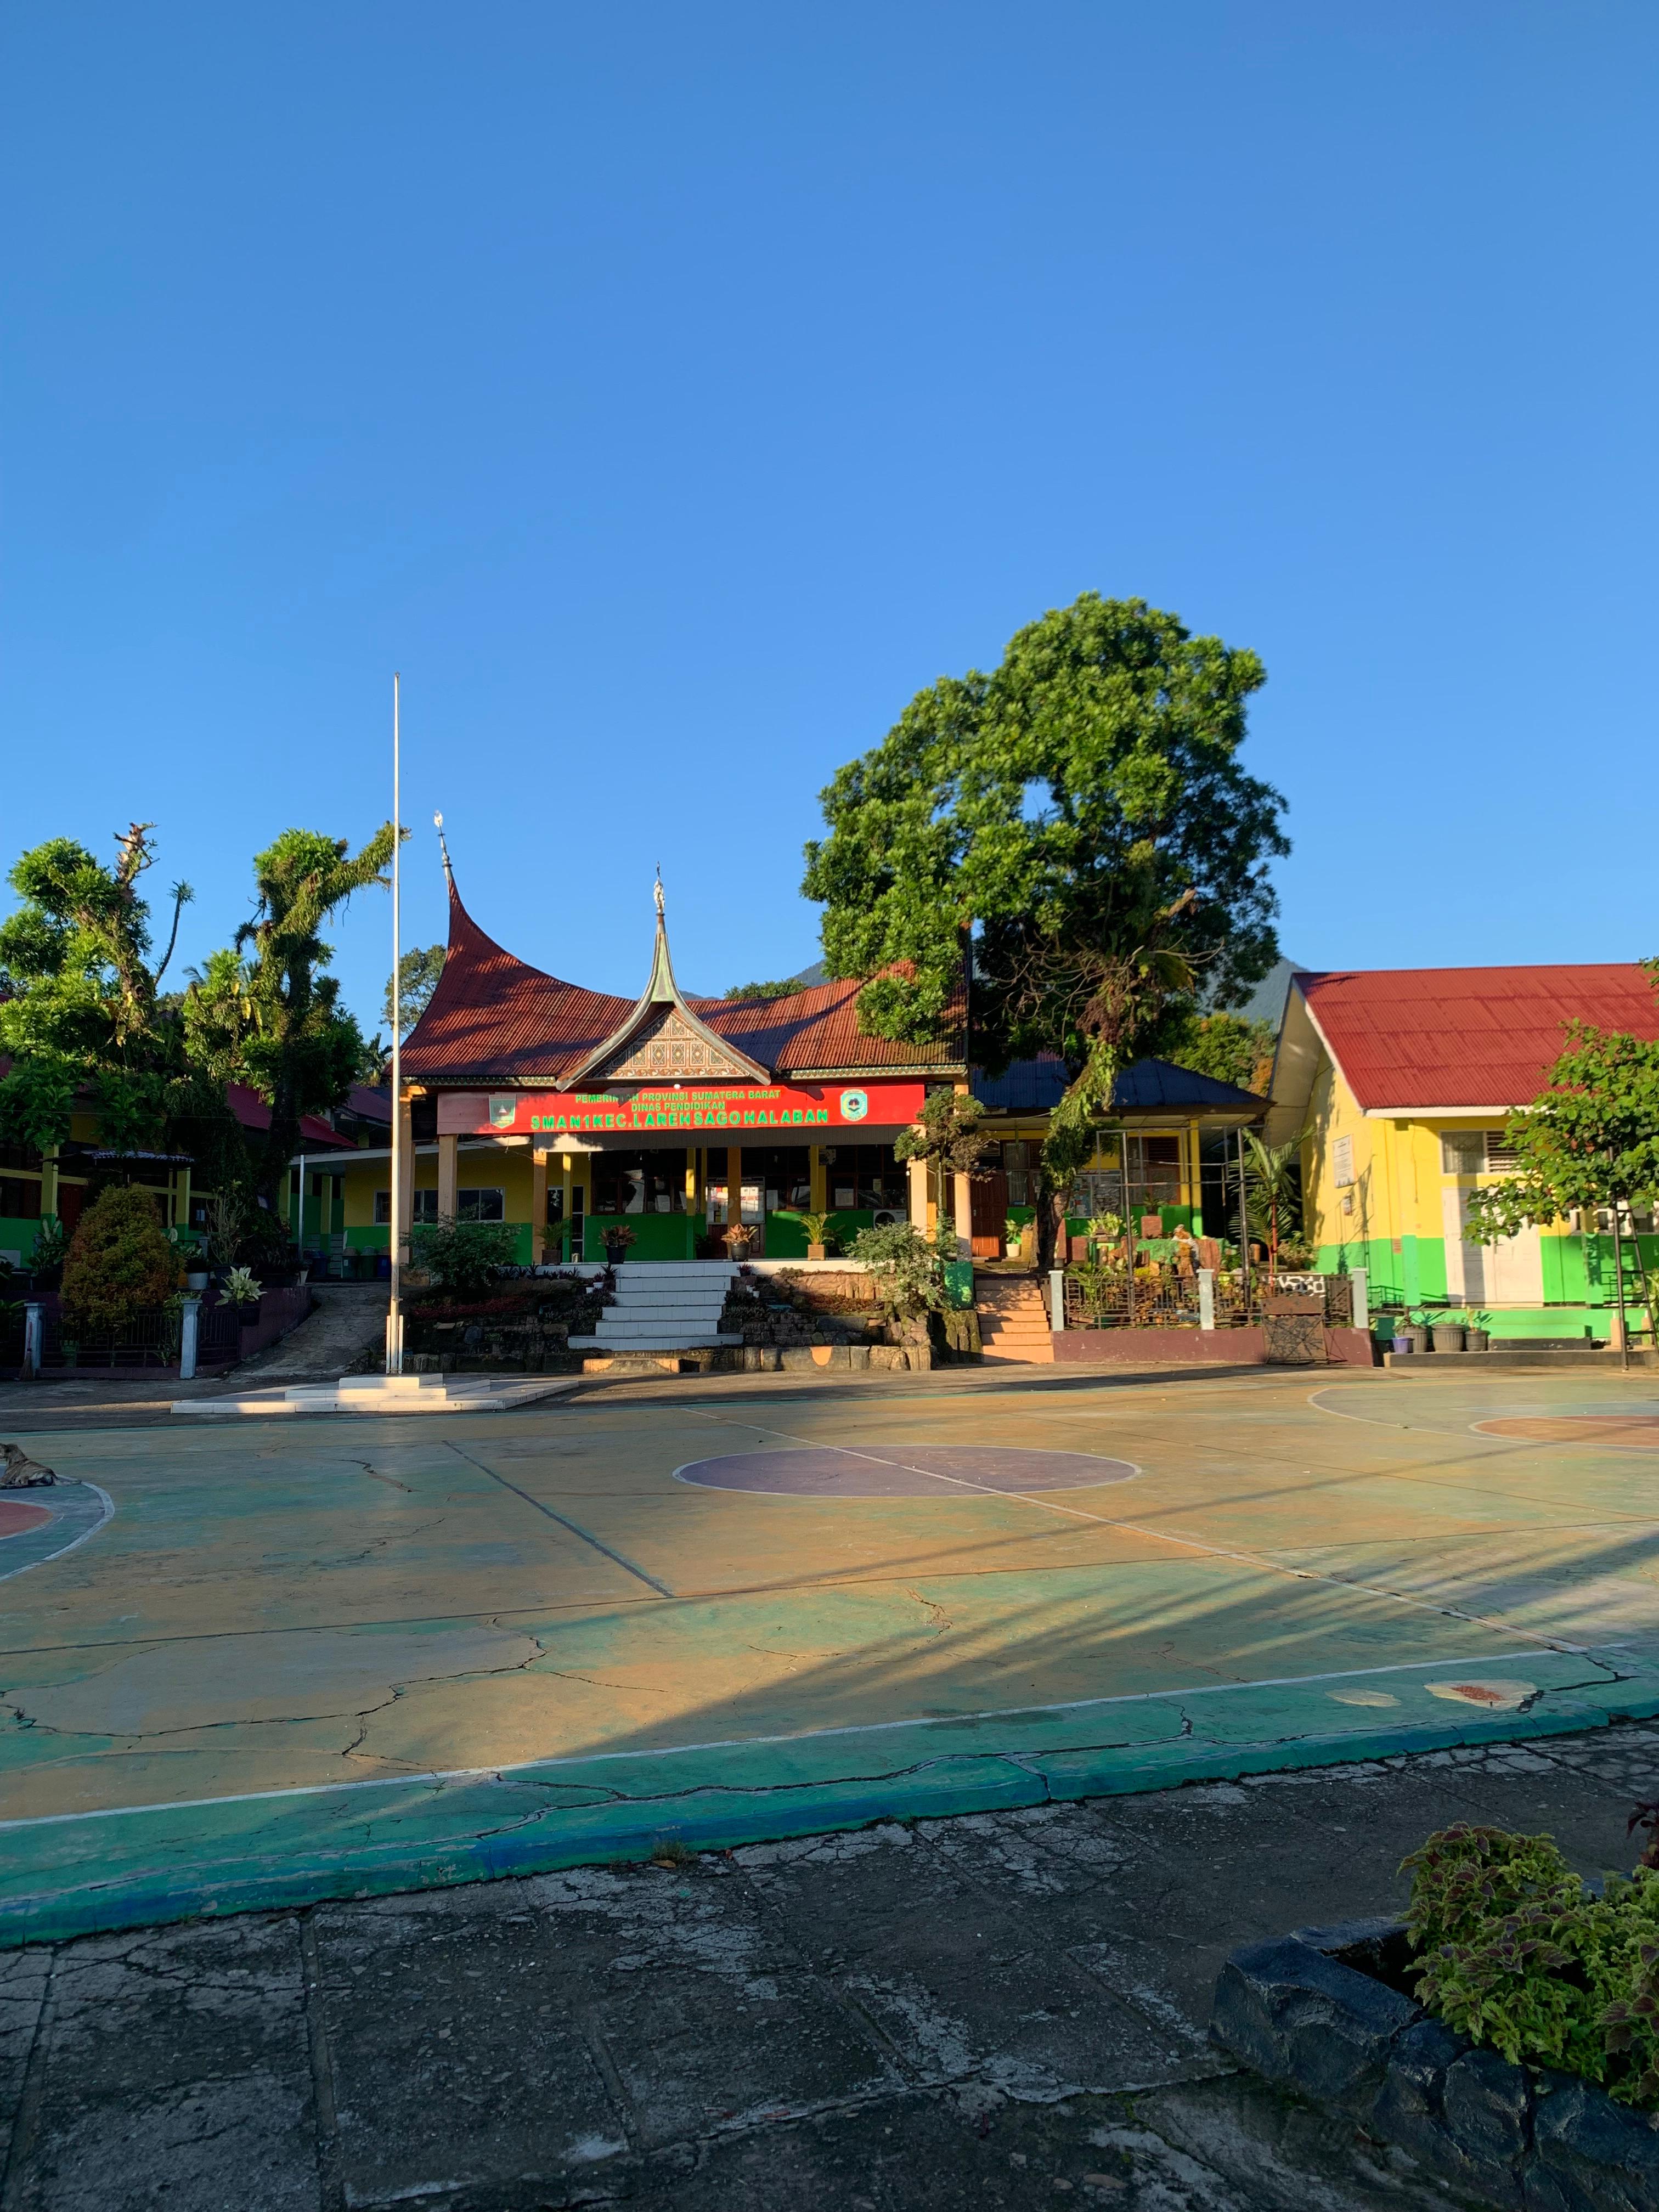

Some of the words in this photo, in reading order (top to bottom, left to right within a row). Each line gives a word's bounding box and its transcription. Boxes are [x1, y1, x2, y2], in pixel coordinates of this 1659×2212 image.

[642, 1091, 689, 1102] PROVINSI
[692, 1090, 745, 1101] SUMATERA
[748, 1090, 781, 1099] BARAT
[631, 1102, 661, 1112] DINAS
[664, 1101, 725, 1111] PENDIDIKAN
[693, 1111, 741, 1126] SAGO
[744, 1109, 828, 1125] HALABAN
